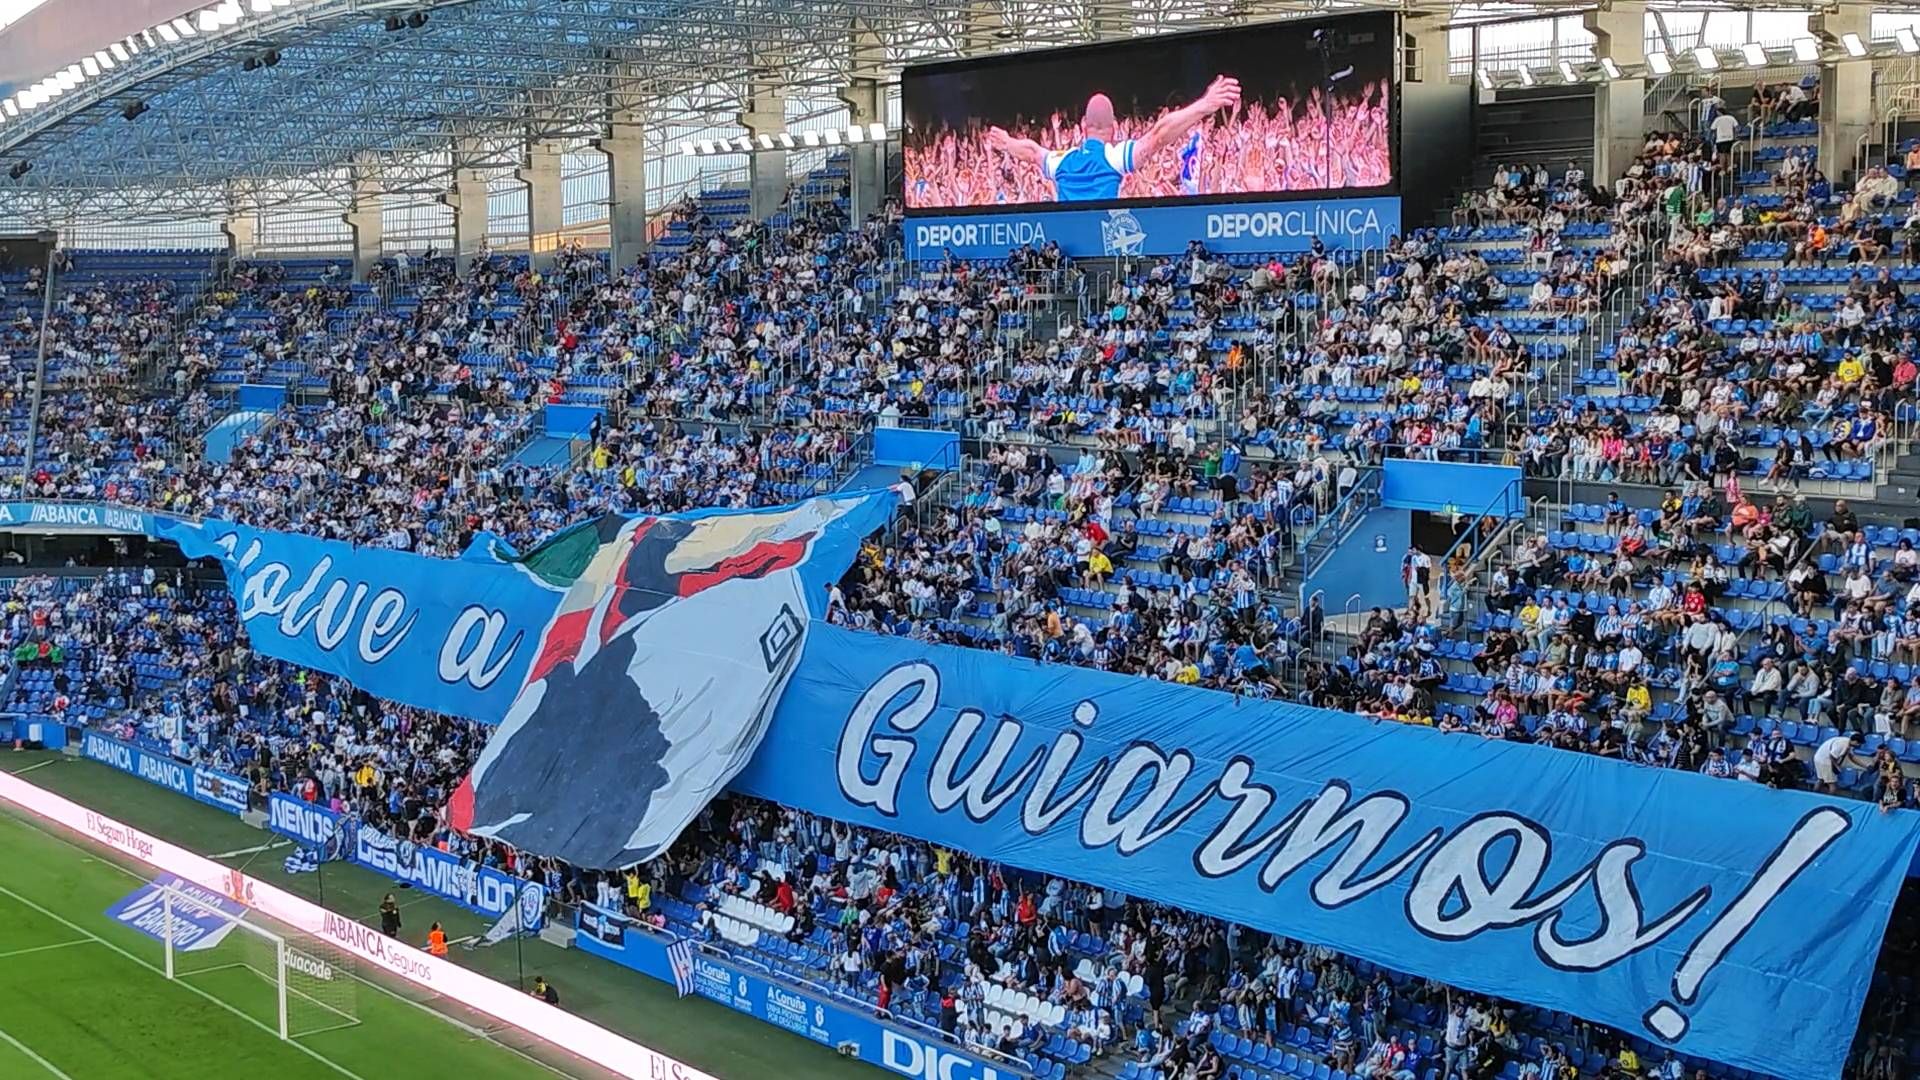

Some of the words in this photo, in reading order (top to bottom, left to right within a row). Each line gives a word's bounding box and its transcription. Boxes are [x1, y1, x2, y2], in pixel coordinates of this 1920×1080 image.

[917, 221, 1046, 247] DEPORTIENDA
[1207, 205, 1381, 239] DEPORCLÍNICA
[96, 815, 126, 845] Seguro
[437, 603, 525, 690] a
[836, 658, 1853, 1045] Guiarnos!
[387, 945, 432, 981] Seguros
[702, 961, 731, 983] Coruña
[768, 985, 775, 999] A
[775, 989, 807, 1012] Coruña
